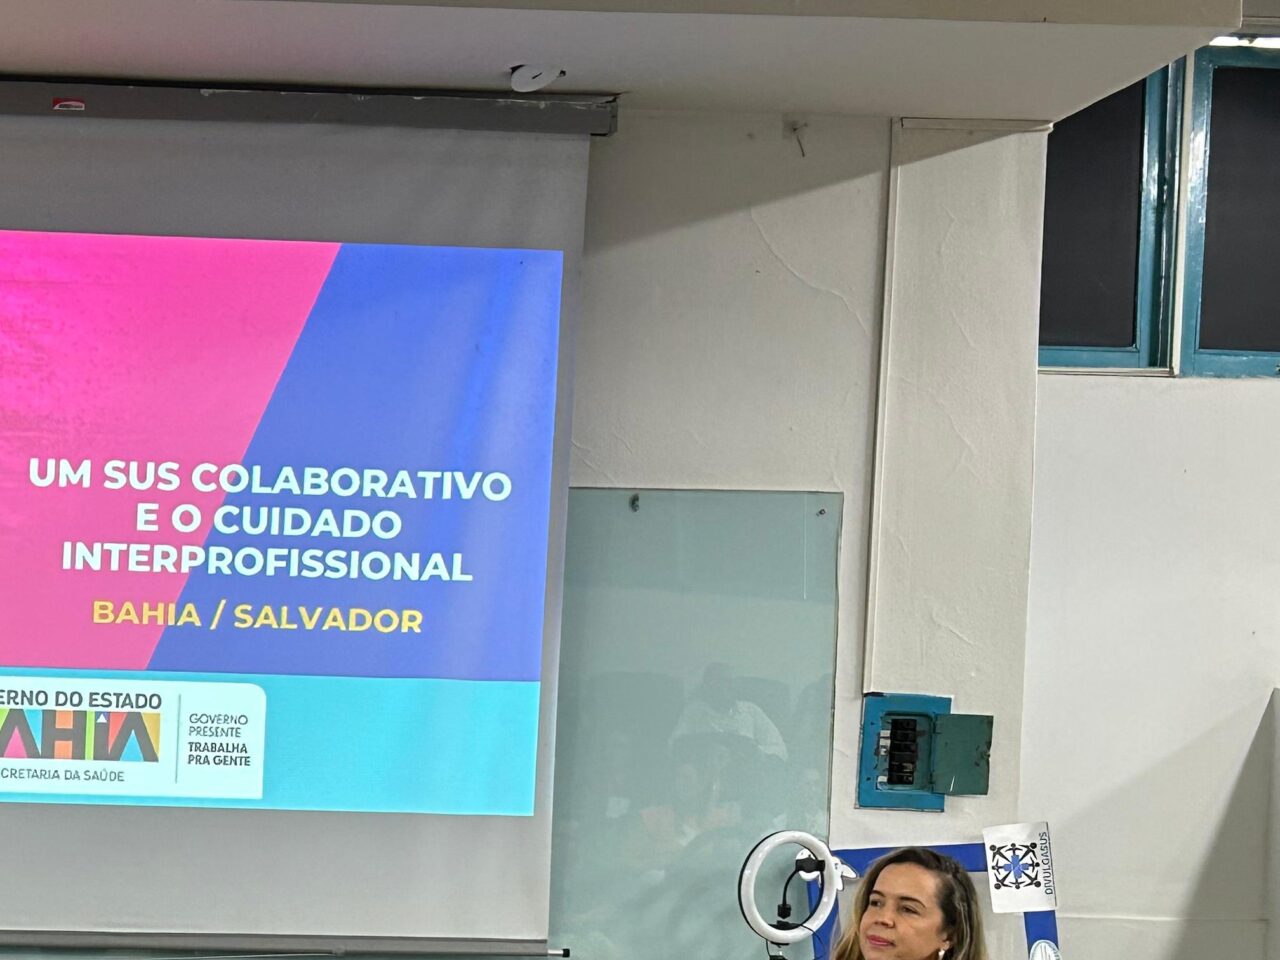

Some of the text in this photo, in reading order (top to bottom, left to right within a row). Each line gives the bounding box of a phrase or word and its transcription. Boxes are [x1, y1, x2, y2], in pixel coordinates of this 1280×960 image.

[29, 457, 513, 501] UM SUS COLABORATIVO
[136, 503, 402, 539] E O CUIDADO
[62, 541, 473, 582] INTERPROFISSIONAL
[92, 599, 423, 633] BAHIA / SALVADOR
[55, 690, 84, 708] DO
[88, 691, 162, 710] ESTADO
[189, 713, 248, 725] GOVERNO
[188, 726, 242, 738] PRESENTE
[187, 741, 249, 754] TRABALHA
[187, 754, 251, 766] PRA GENTE
[64, 769, 81, 782] DA
[83, 767, 125, 783] SAÚDE
